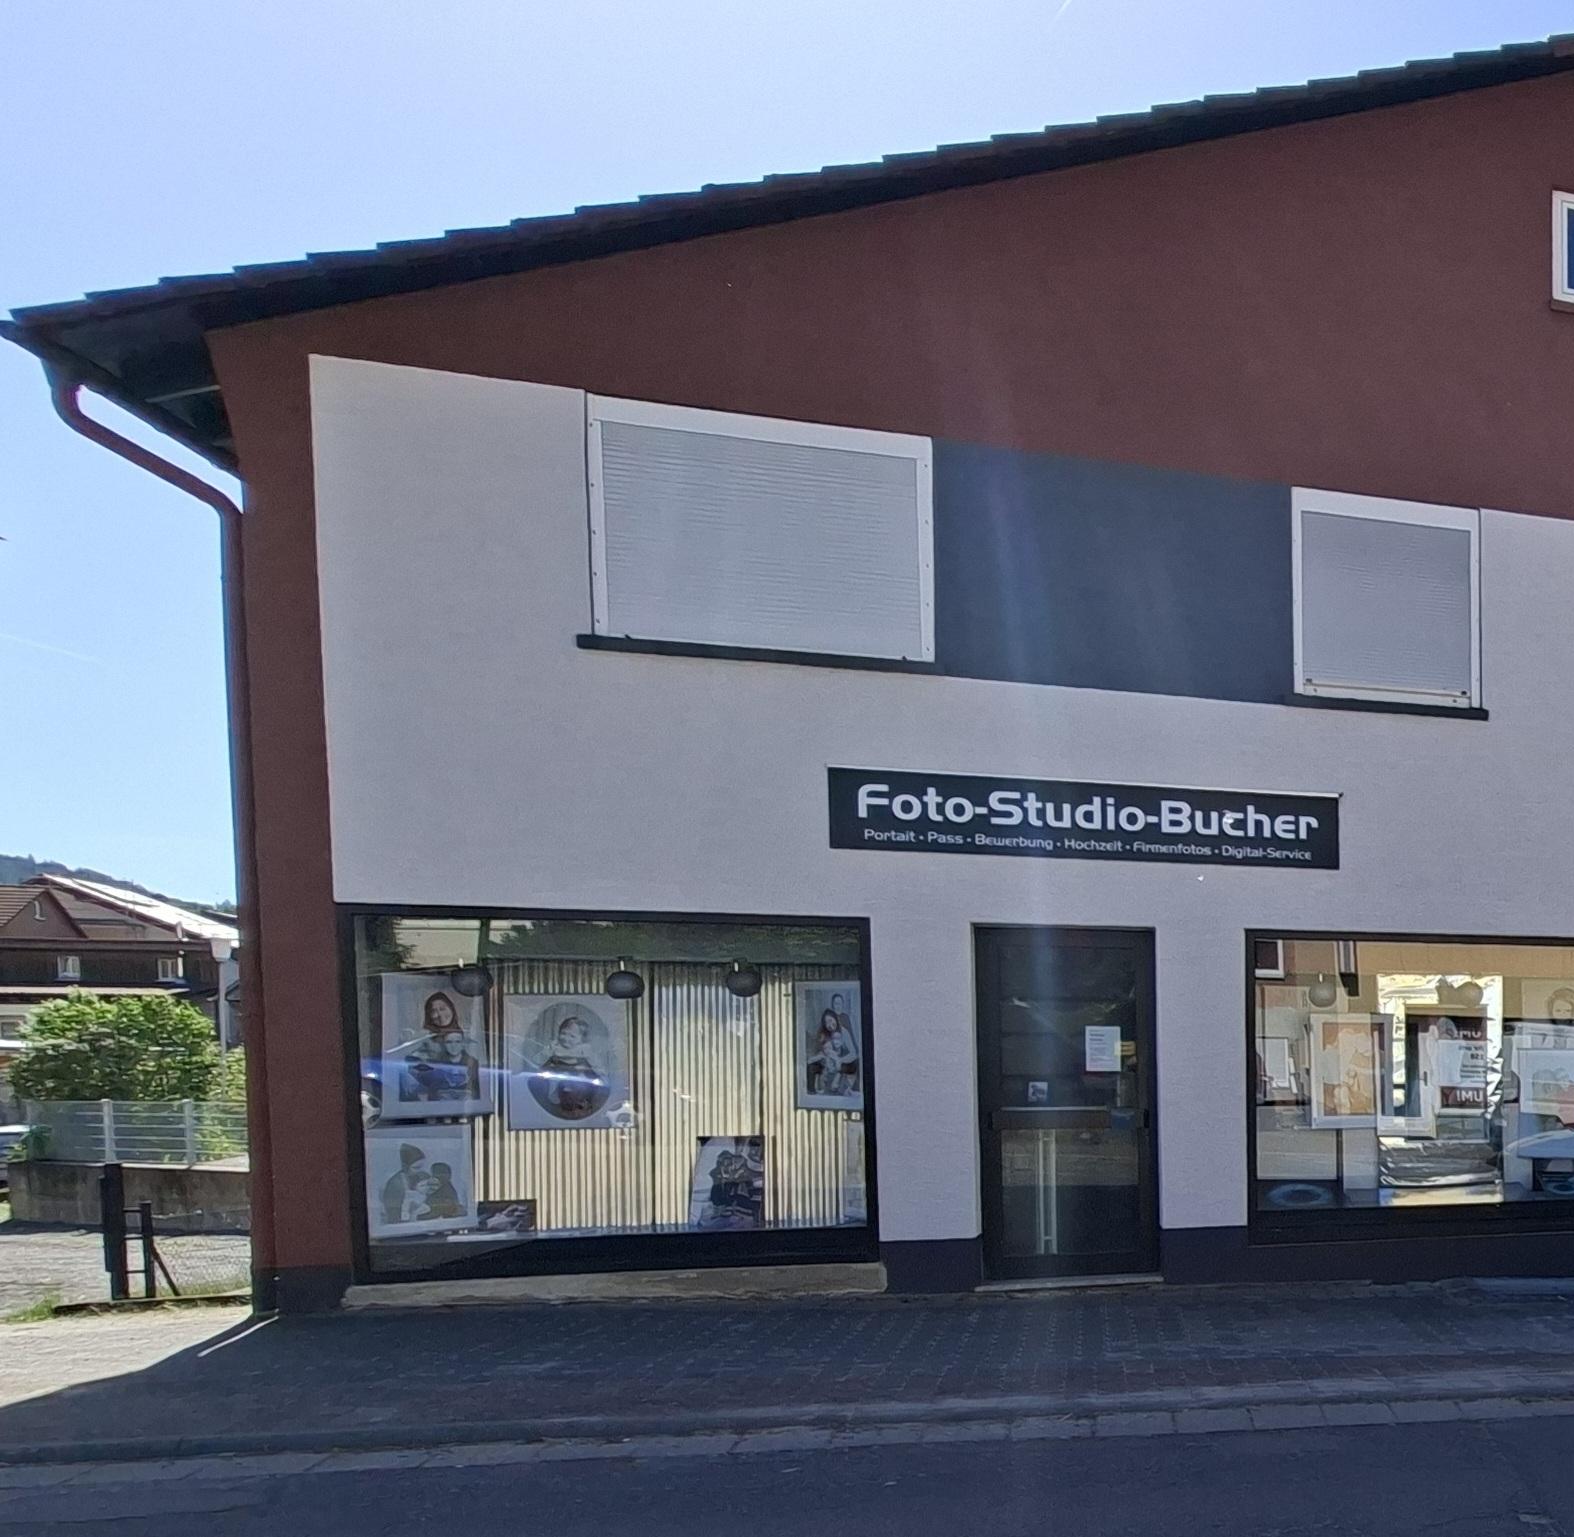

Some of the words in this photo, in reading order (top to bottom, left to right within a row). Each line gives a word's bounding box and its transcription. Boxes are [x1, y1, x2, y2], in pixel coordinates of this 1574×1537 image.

[857, 783, 1319, 840] Foto-Studio-Bucher
[864, 828, 916, 843] Portait
[927, 831, 964, 845] Pass
[974, 833, 1053, 850] Bewerbung
[1064, 838, 1123, 851] Hochzeit
[1132, 841, 1212, 856] Firmenfotos
[1222, 845, 1313, 860] Digital-Service
